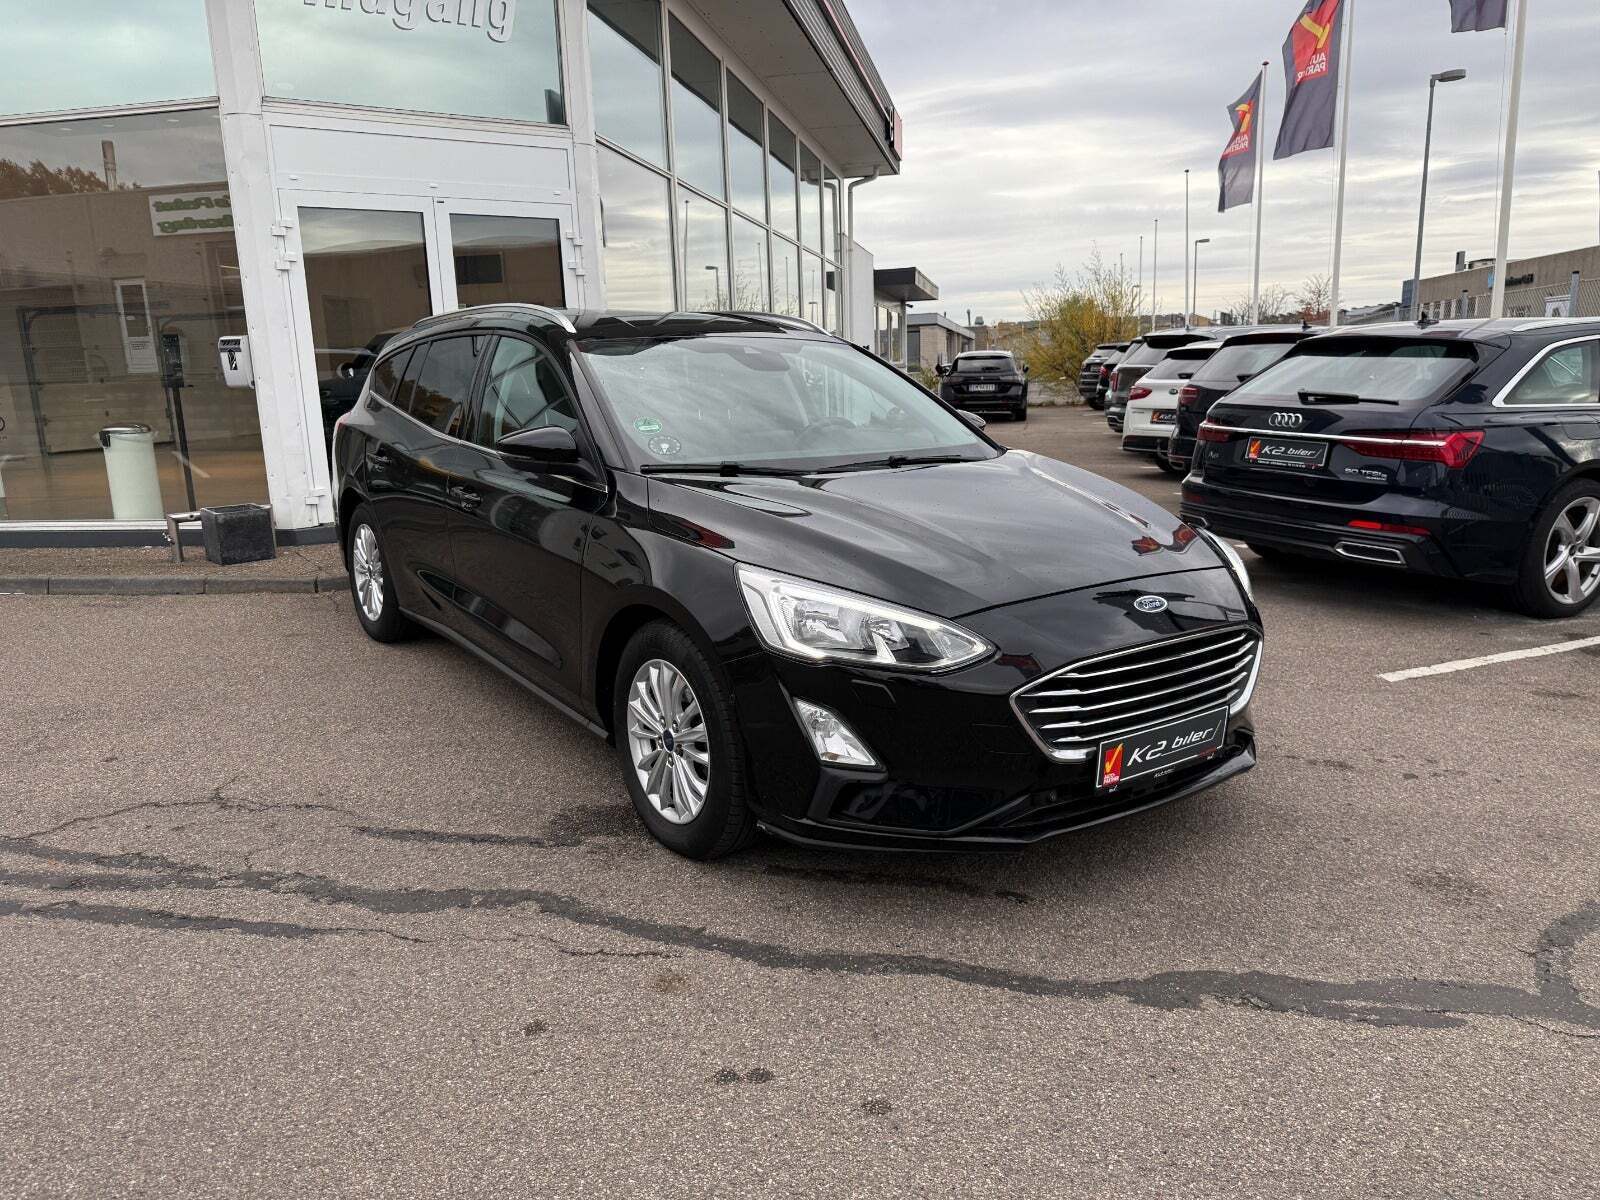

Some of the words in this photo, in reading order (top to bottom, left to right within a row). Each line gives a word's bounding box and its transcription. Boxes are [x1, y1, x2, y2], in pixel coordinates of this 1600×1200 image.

[1261, 445, 1285, 455] K2
[1287, 447, 1317, 456] biler
[1127, 741, 1167, 767] K2
[1171, 728, 1214, 749] biler
